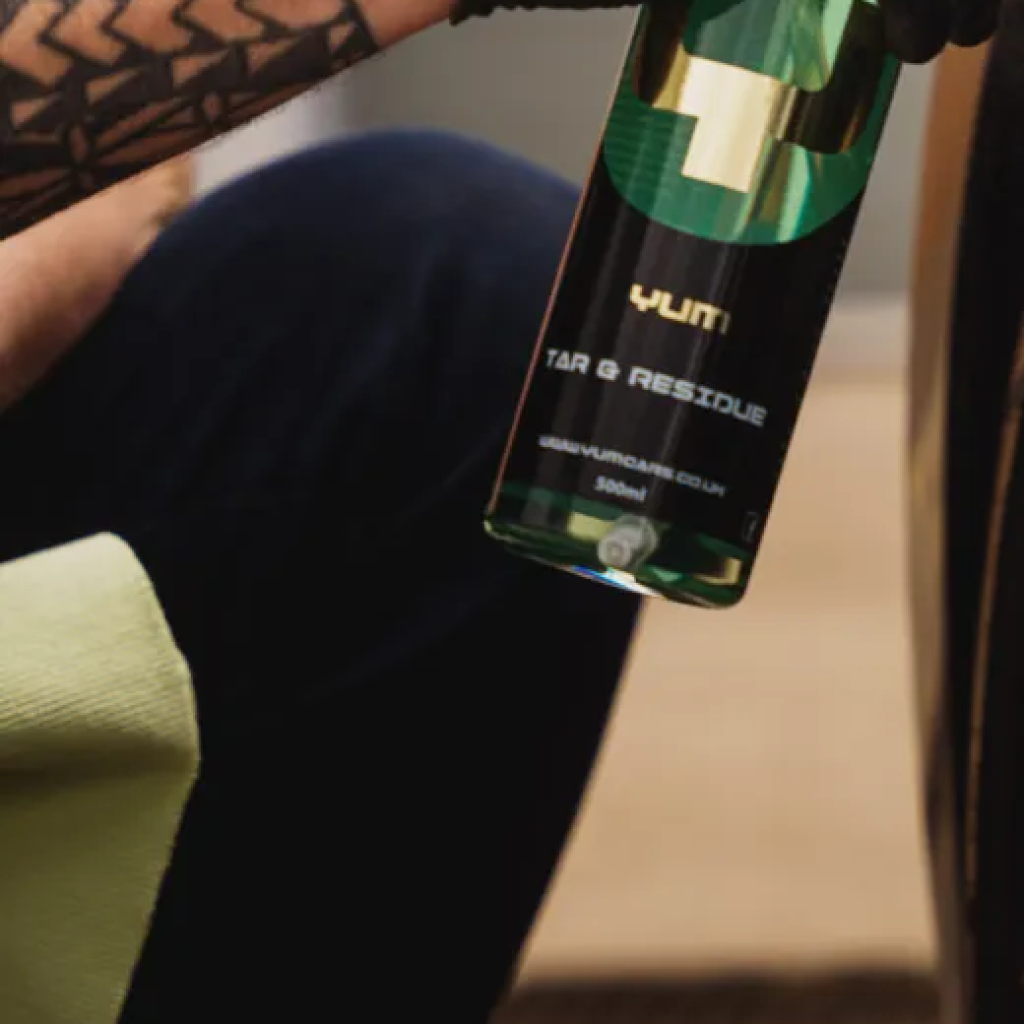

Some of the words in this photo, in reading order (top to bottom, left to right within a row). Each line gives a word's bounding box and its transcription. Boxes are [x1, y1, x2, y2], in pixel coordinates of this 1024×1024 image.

[630, 283, 730, 333] YUM
[546, 349, 590, 374] TAR
[597, 359, 620, 381] &
[628, 366, 767, 426] RESIDUE
[595, 476, 648, 501] 500ml
